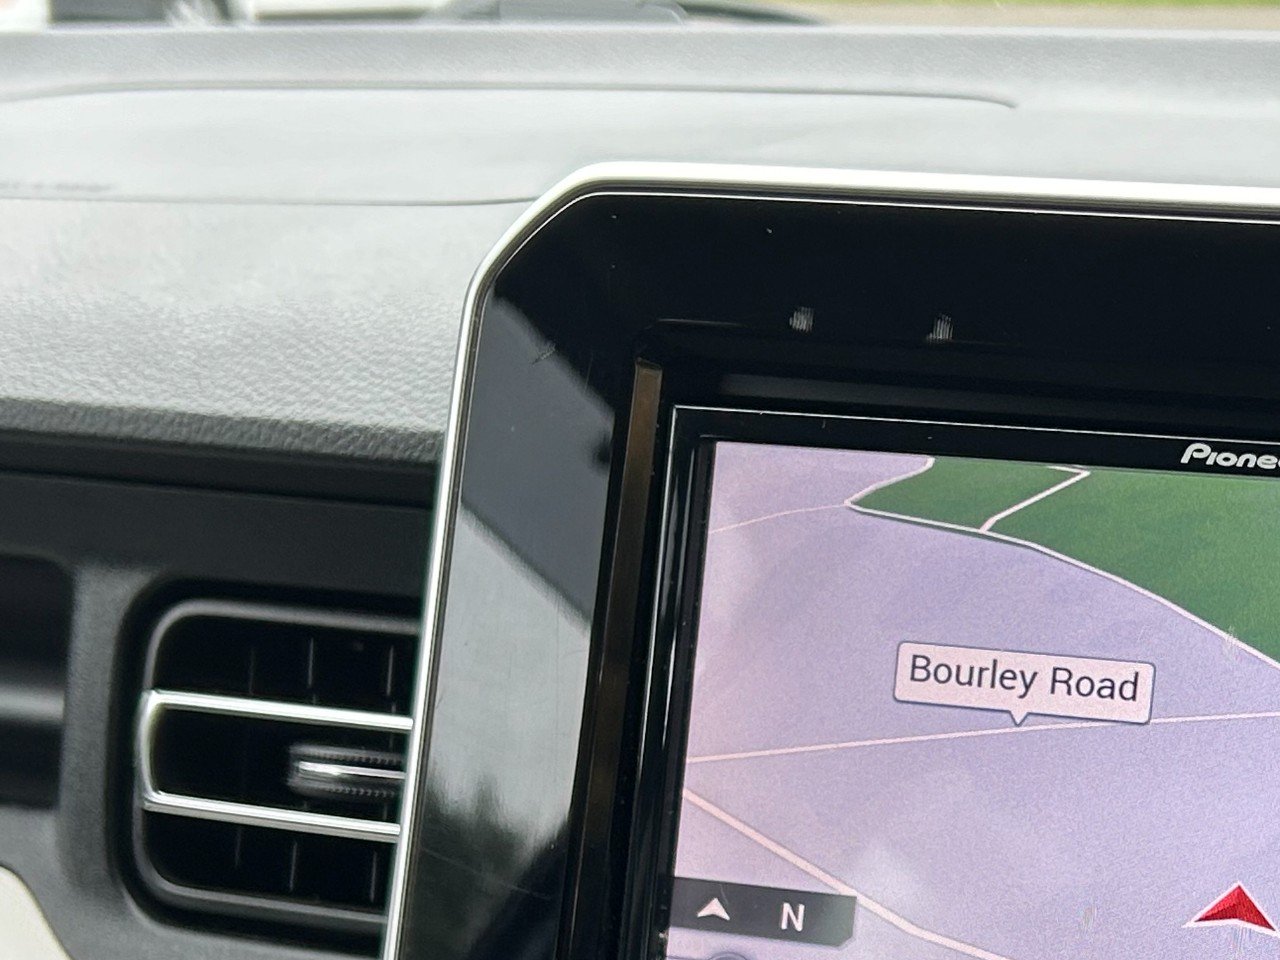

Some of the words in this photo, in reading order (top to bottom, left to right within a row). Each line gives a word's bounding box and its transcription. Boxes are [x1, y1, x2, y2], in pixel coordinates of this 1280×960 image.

[909, 654, 1038, 698] Bourley
[1051, 666, 1139, 702] Road
[780, 903, 805, 932] N
